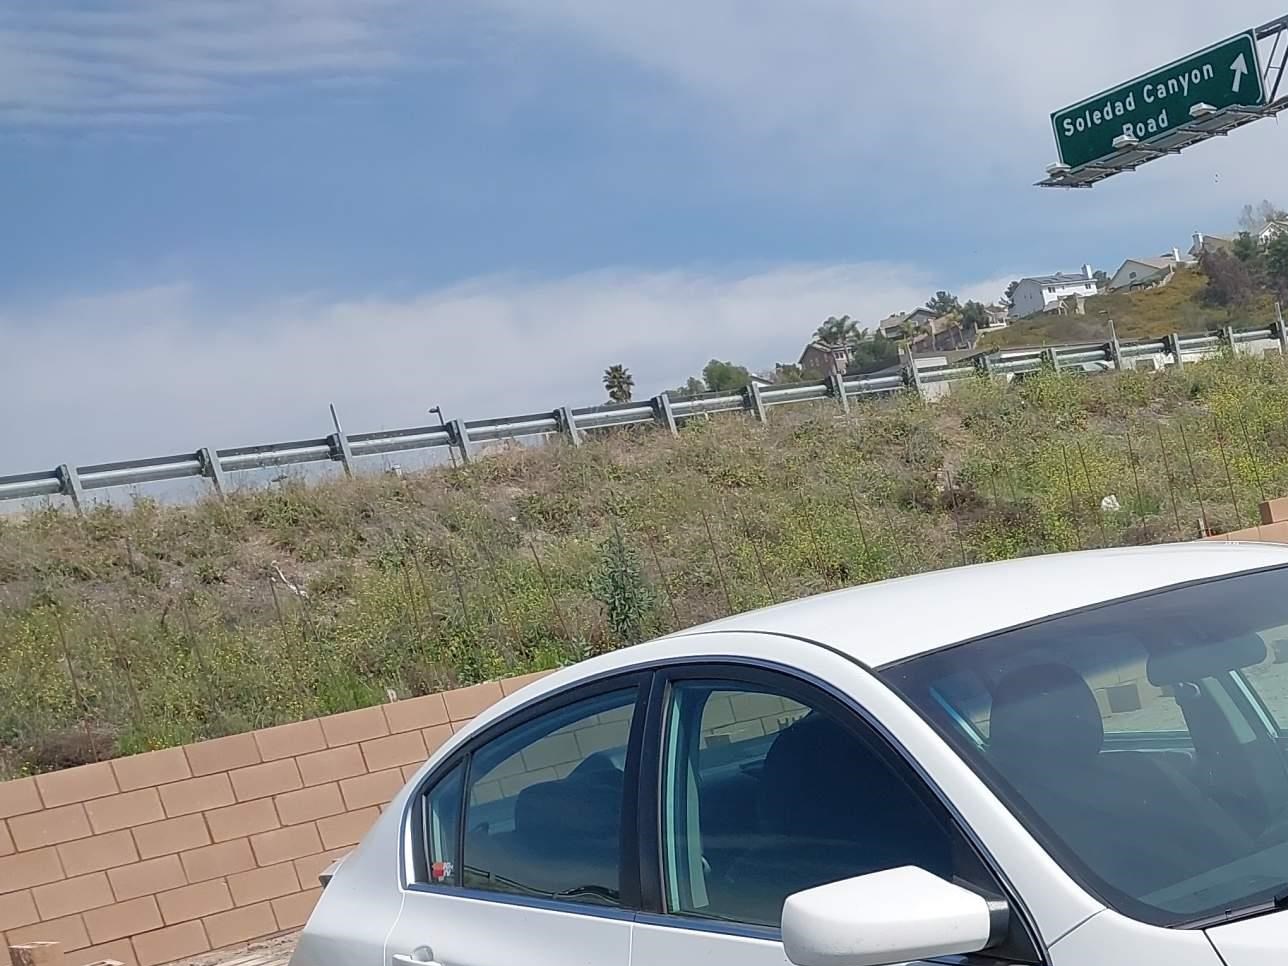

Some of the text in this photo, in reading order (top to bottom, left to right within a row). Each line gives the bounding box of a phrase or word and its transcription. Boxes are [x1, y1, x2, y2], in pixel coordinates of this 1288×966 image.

[1063, 62, 1214, 137] Soledad Canyon
[1122, 110, 1169, 139] Road
